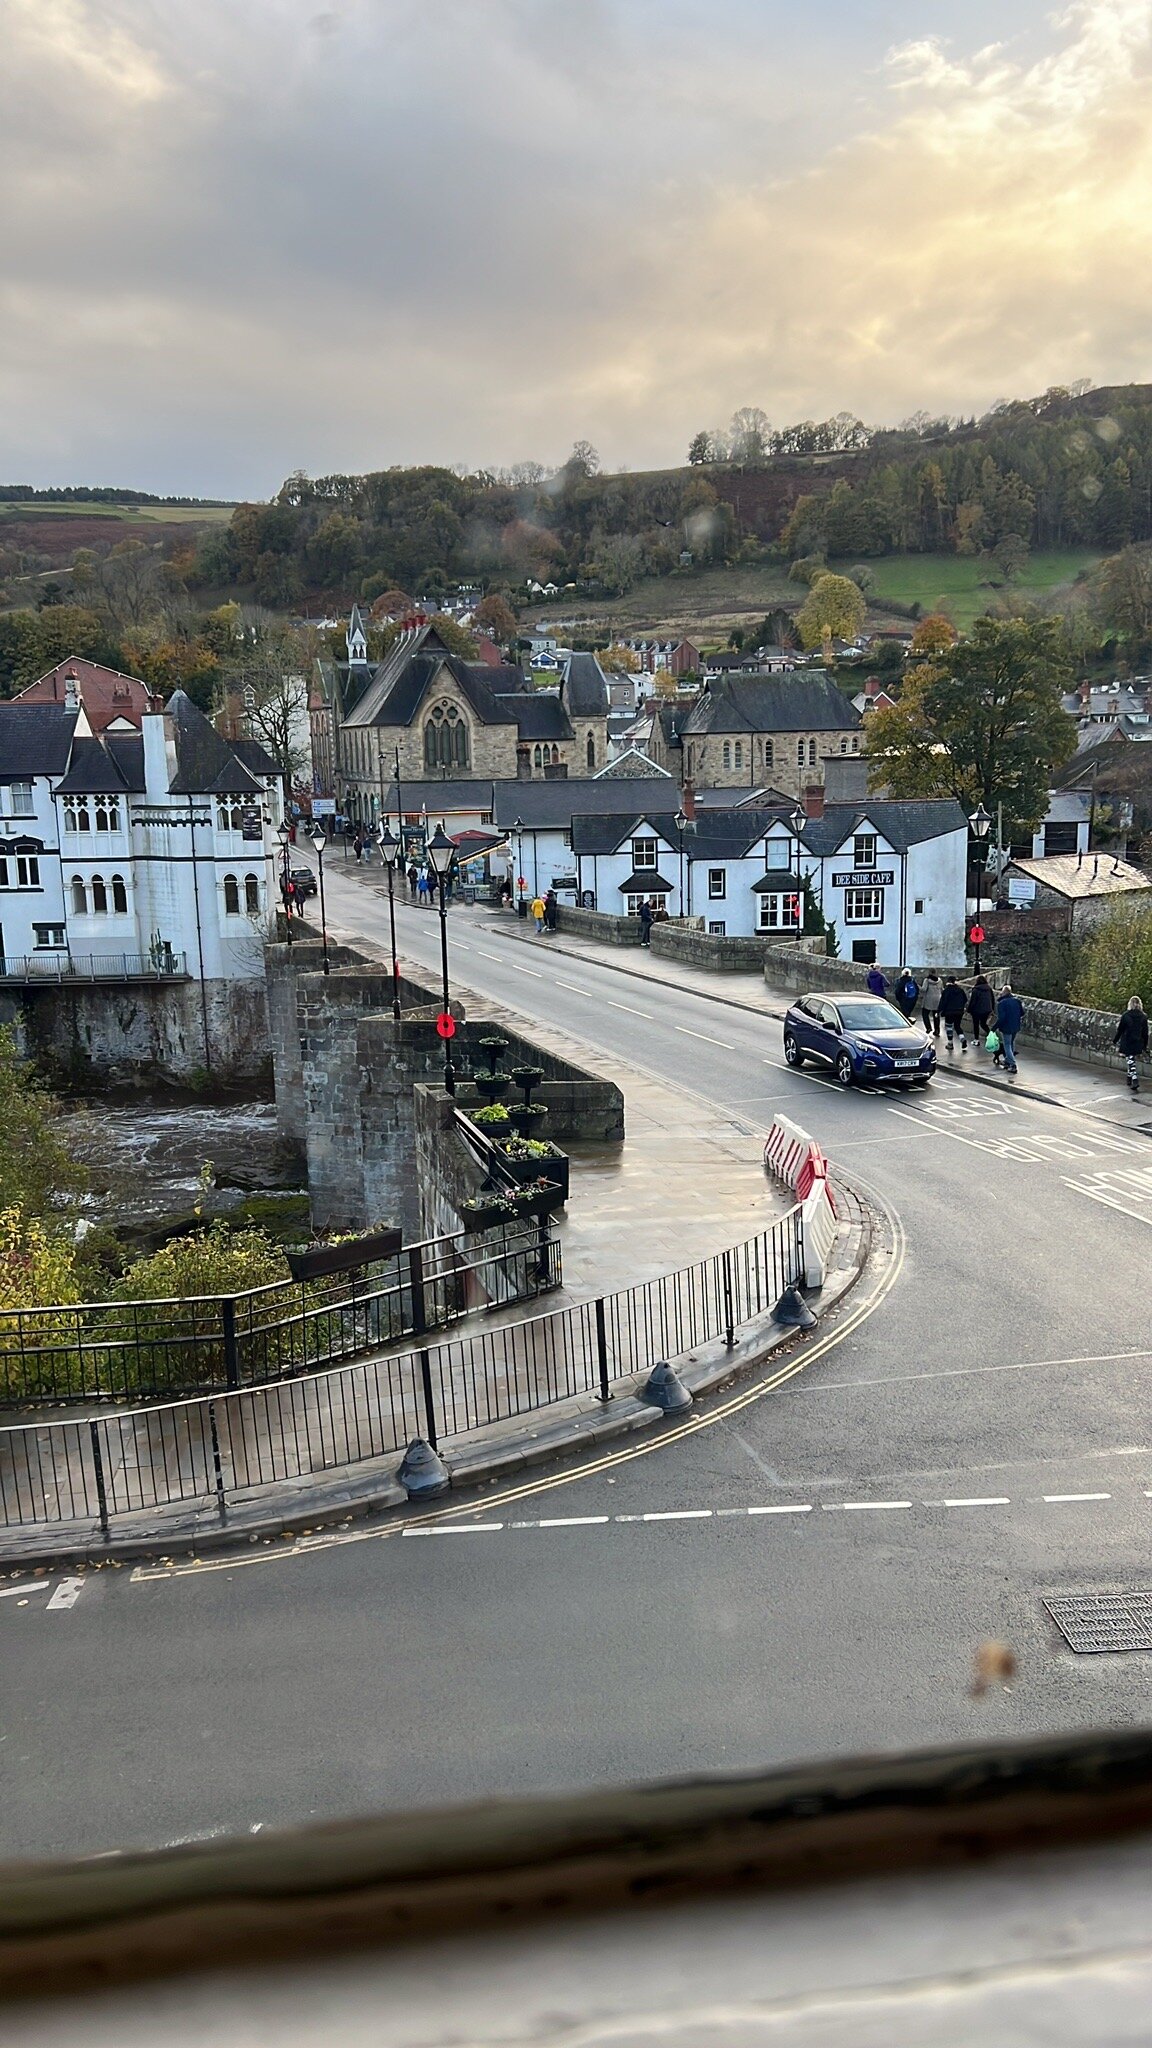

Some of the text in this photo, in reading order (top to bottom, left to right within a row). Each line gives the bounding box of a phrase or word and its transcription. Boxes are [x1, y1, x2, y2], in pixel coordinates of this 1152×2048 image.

[836, 873, 891, 885] DEE SIDE CAFE
[918, 1096, 1030, 1118] KEEP
